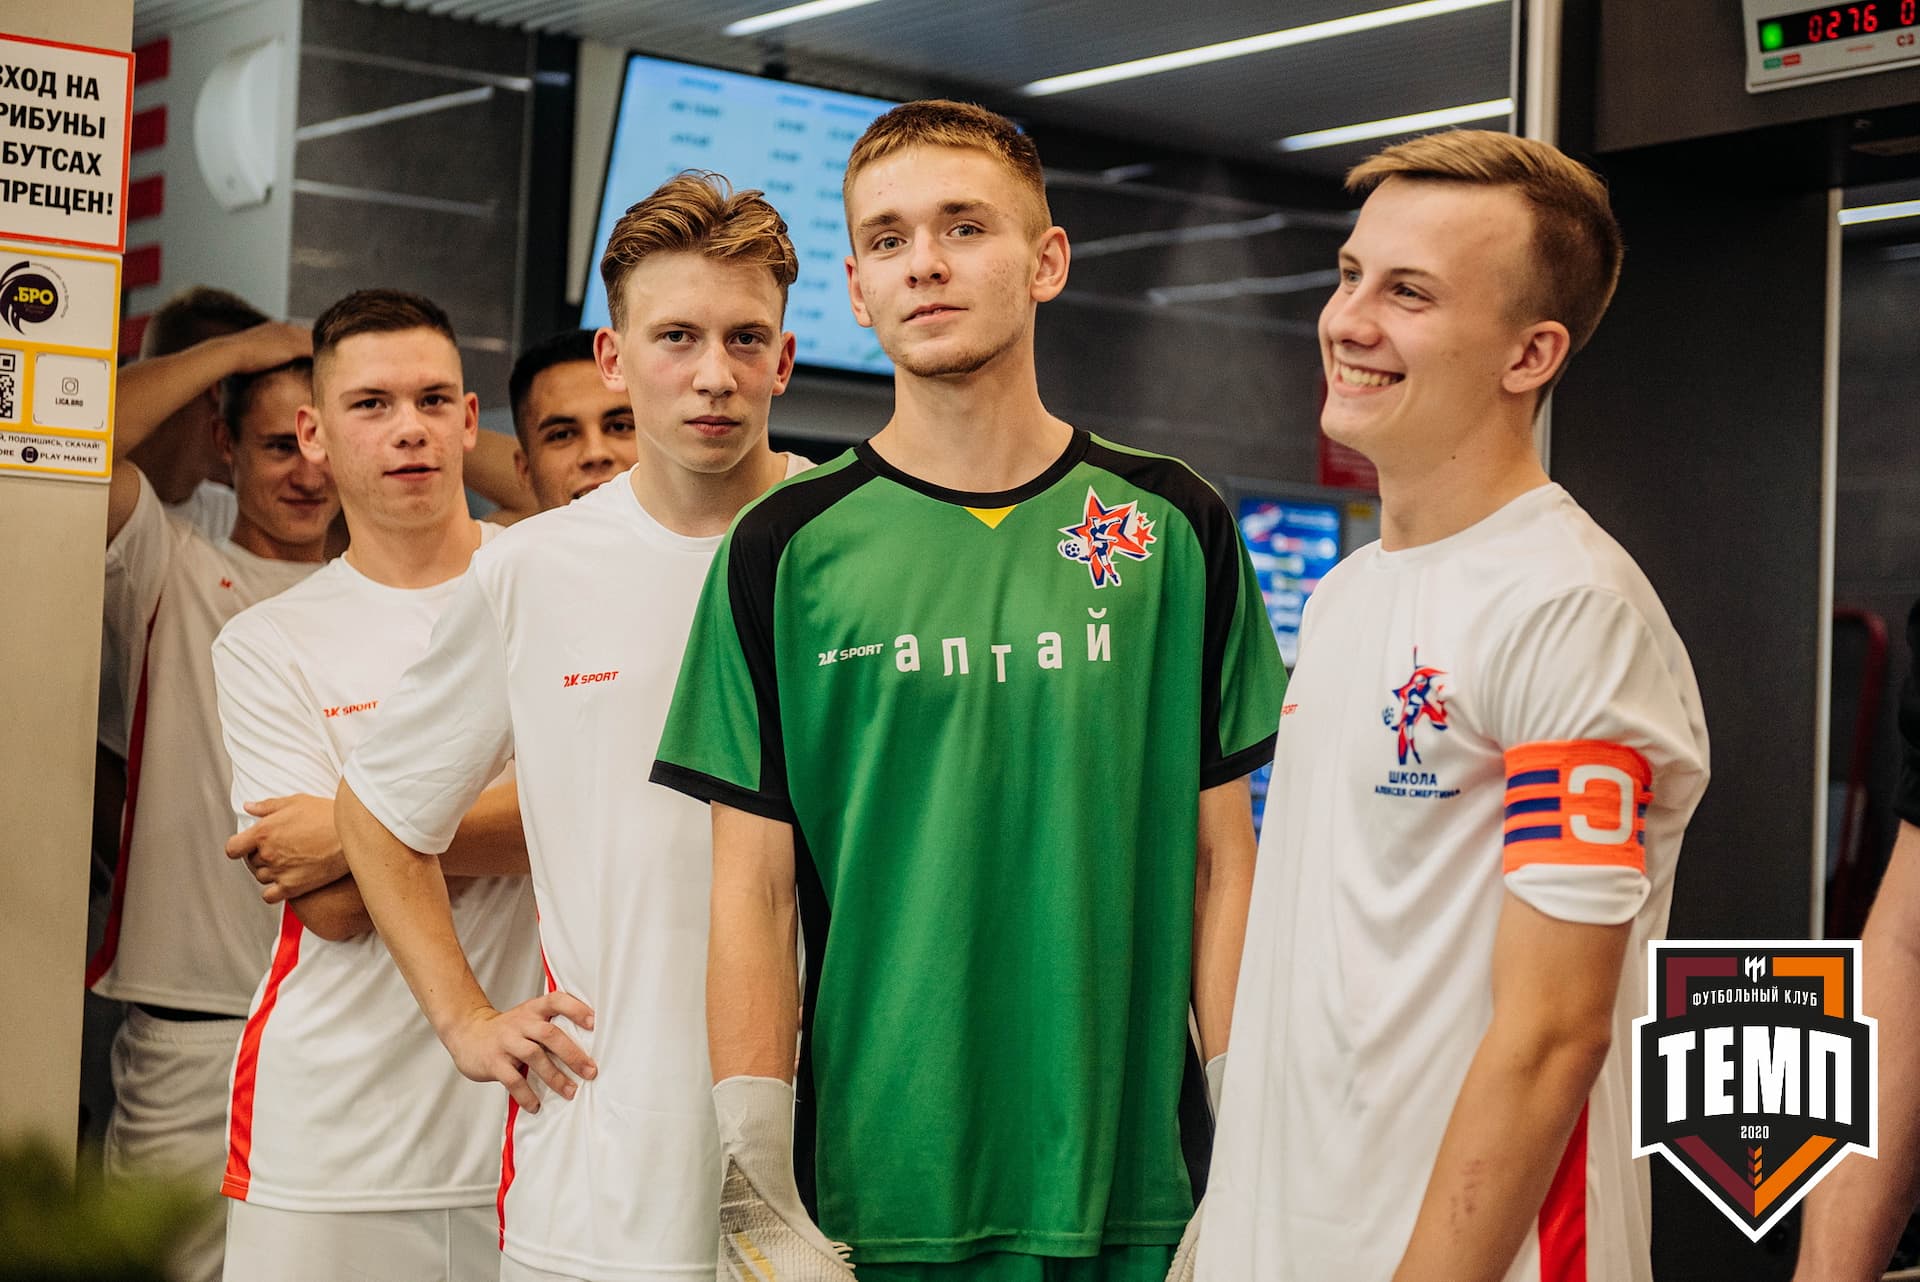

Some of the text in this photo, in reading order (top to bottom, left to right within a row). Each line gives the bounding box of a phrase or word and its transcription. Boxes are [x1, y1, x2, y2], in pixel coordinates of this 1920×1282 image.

[1808, 4, 1878, 43] 0276
[0, 65, 100, 101] ХОД НА
[2, 141, 102, 176] БУТСАХ
[8, 435, 63, 447] ПОДПИШИСЬ,
[65, 440, 100, 449] СКАЧАЙ!
[40, 453, 61, 461] PLAY
[63, 455, 98, 464] MARKET
[840, 643, 884, 660] SPORT
[580, 671, 619, 684] SPORT
[342, 700, 379, 715] SPORT
[1389, 770, 1437, 786] ШКОЛА
